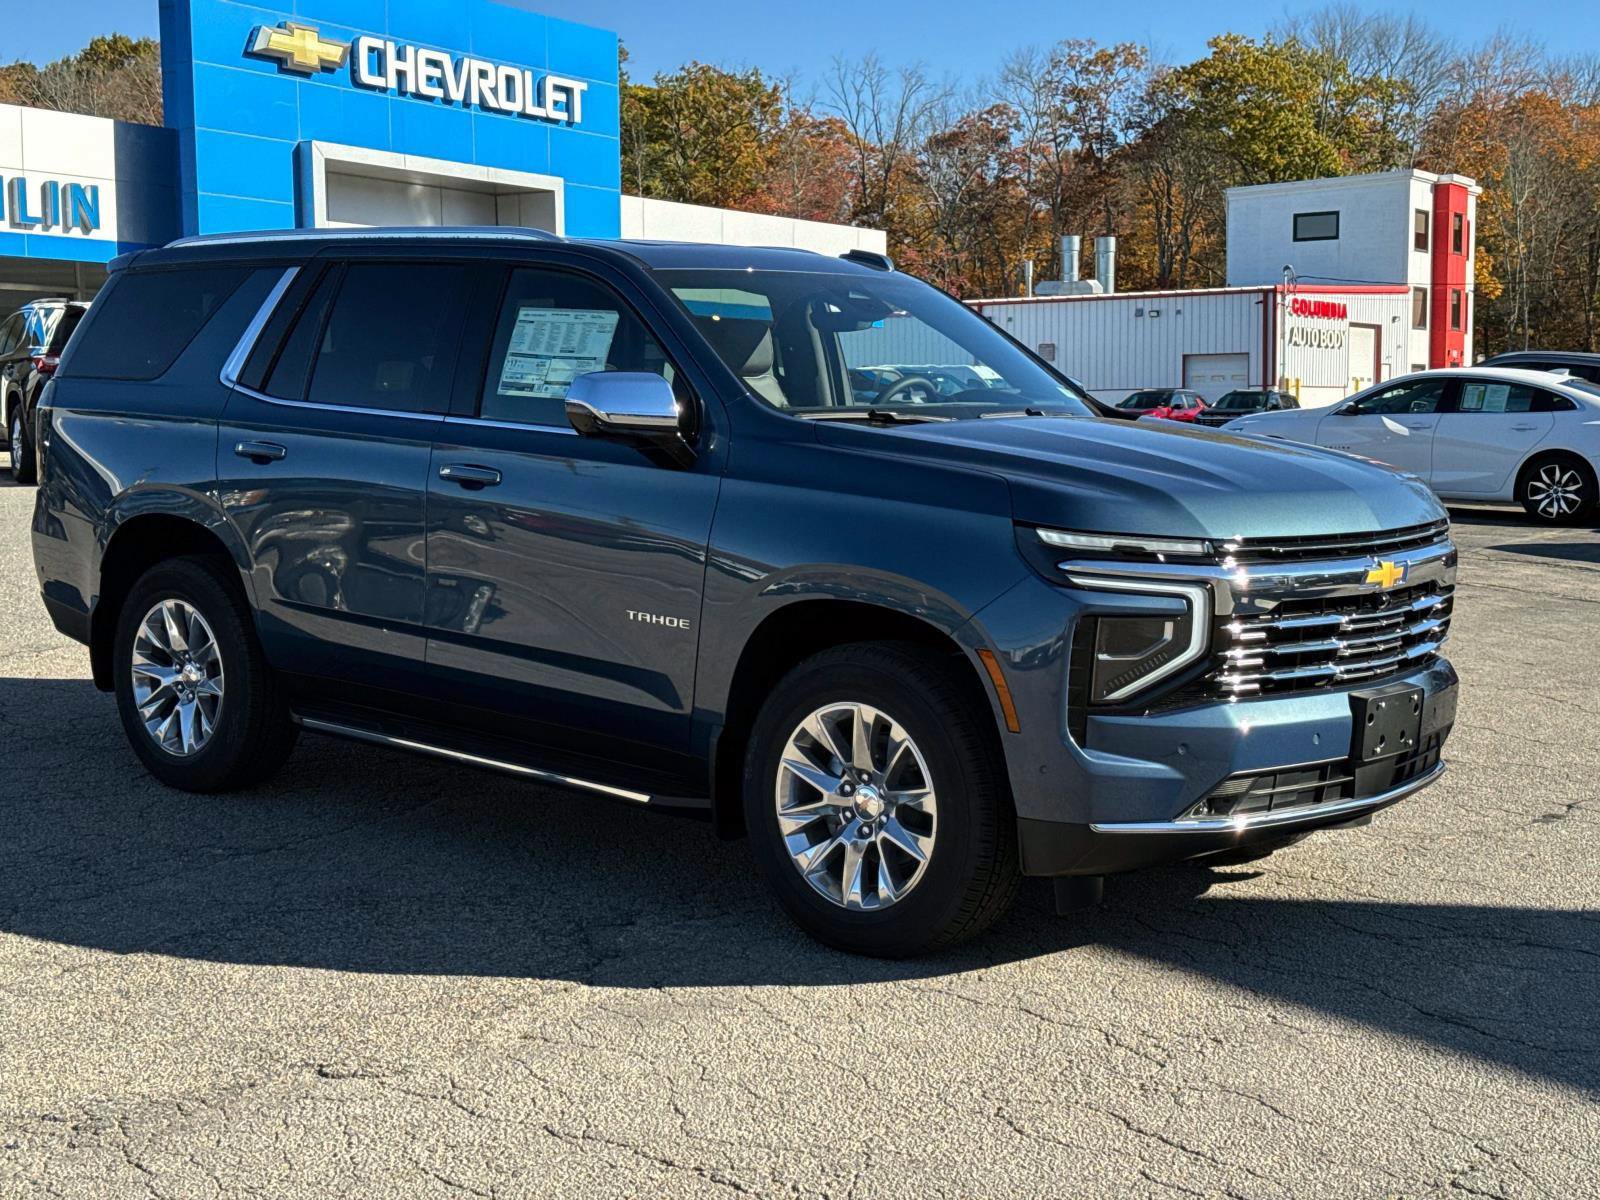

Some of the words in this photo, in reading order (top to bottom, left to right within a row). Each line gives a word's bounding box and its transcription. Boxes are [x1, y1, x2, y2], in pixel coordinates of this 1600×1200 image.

[354, 35, 588, 124] CHEVROLET
[0, 174, 101, 232] LIN
[1291, 297, 1348, 319] COLUMBIA
[625, 609, 691, 630] TAHOE
